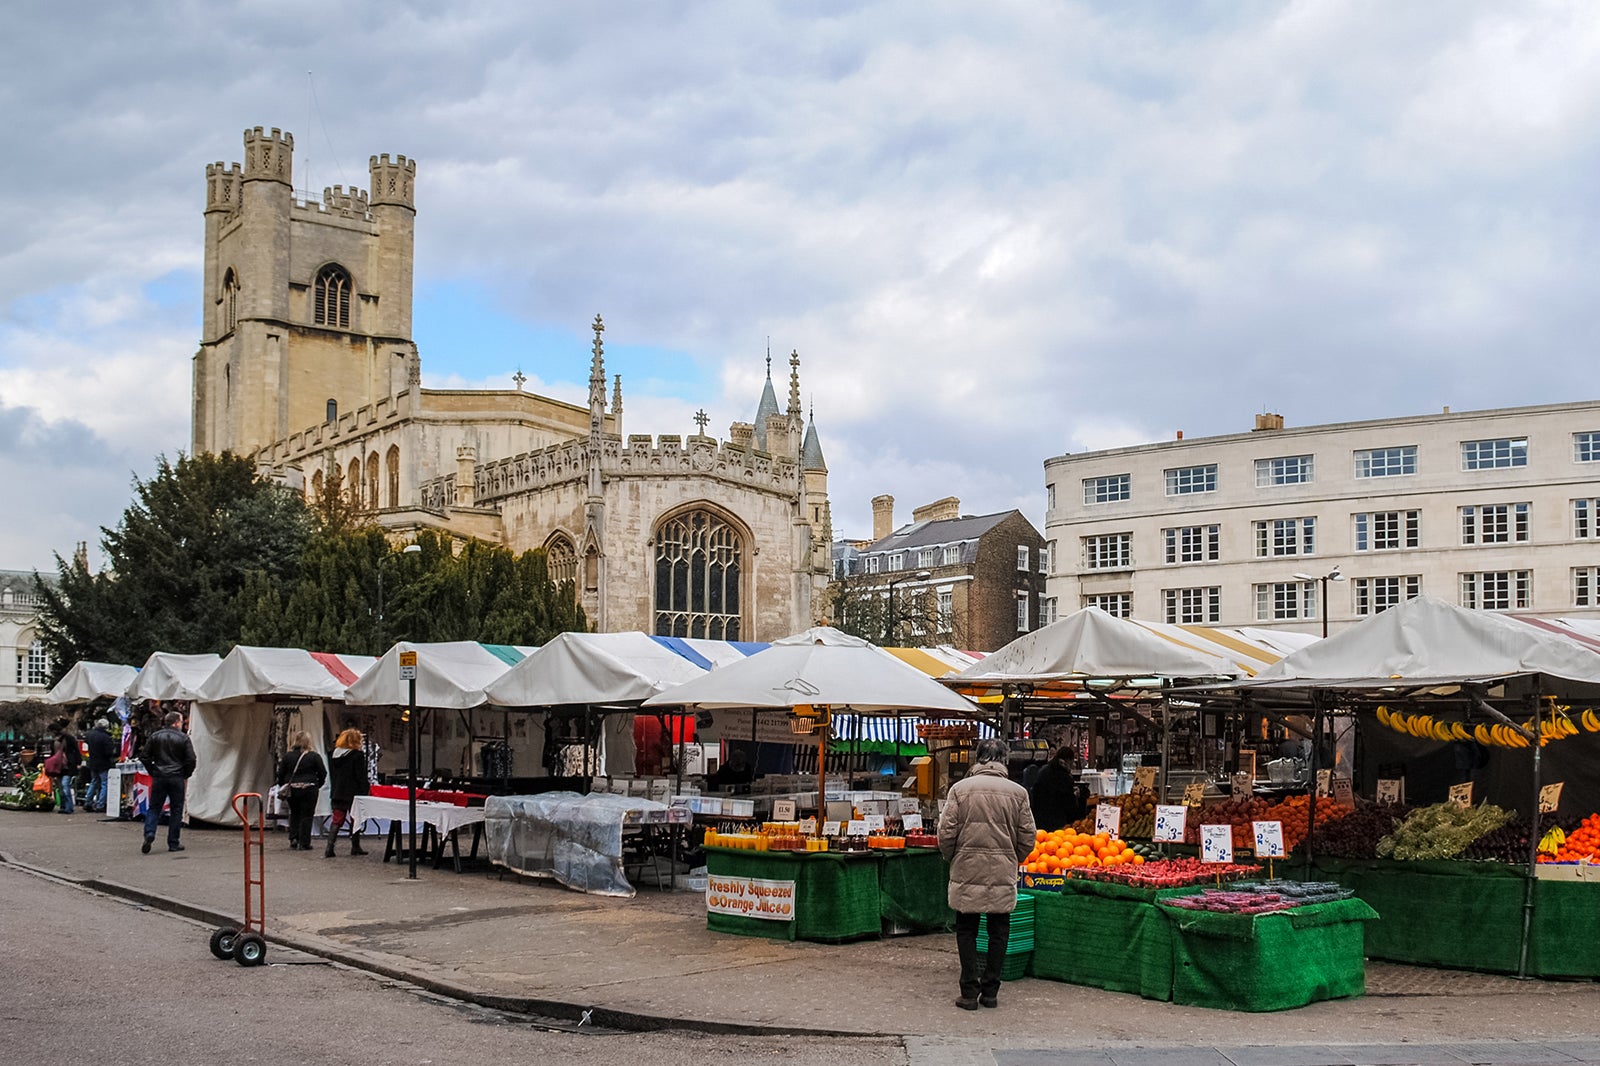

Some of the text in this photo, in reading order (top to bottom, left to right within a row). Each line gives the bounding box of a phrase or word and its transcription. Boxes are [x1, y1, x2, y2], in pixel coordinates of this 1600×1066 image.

[1097, 818, 1104, 830] 4
[1157, 816, 1165, 830] 2
[1205, 838, 1212, 852] 2
[1257, 833, 1263, 846] 2
[709, 879, 792, 898] Freshly Squeezed
[719, 895, 781, 913] Orange Juice
